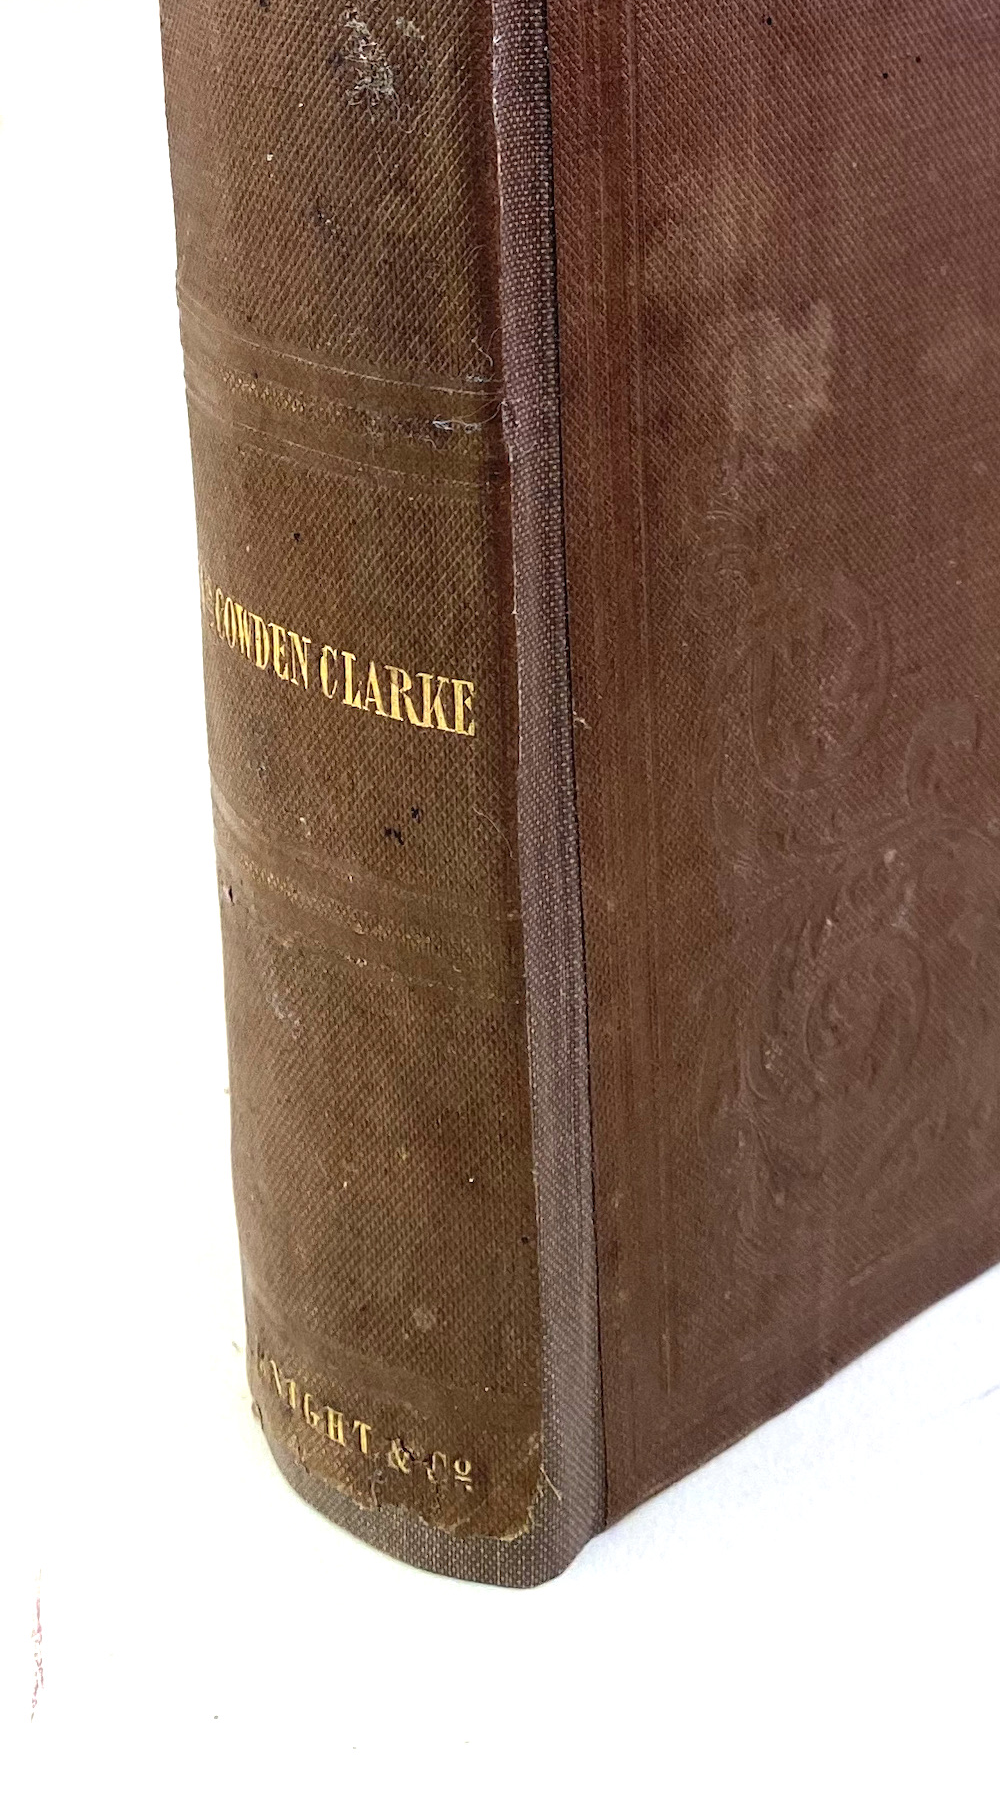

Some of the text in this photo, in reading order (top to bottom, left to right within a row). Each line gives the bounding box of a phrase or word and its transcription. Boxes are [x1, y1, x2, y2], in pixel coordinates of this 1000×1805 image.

[214, 587, 312, 690] COWDEN
[319, 644, 476, 737] CLARKE
[259, 1355, 372, 1455] NIGHT
